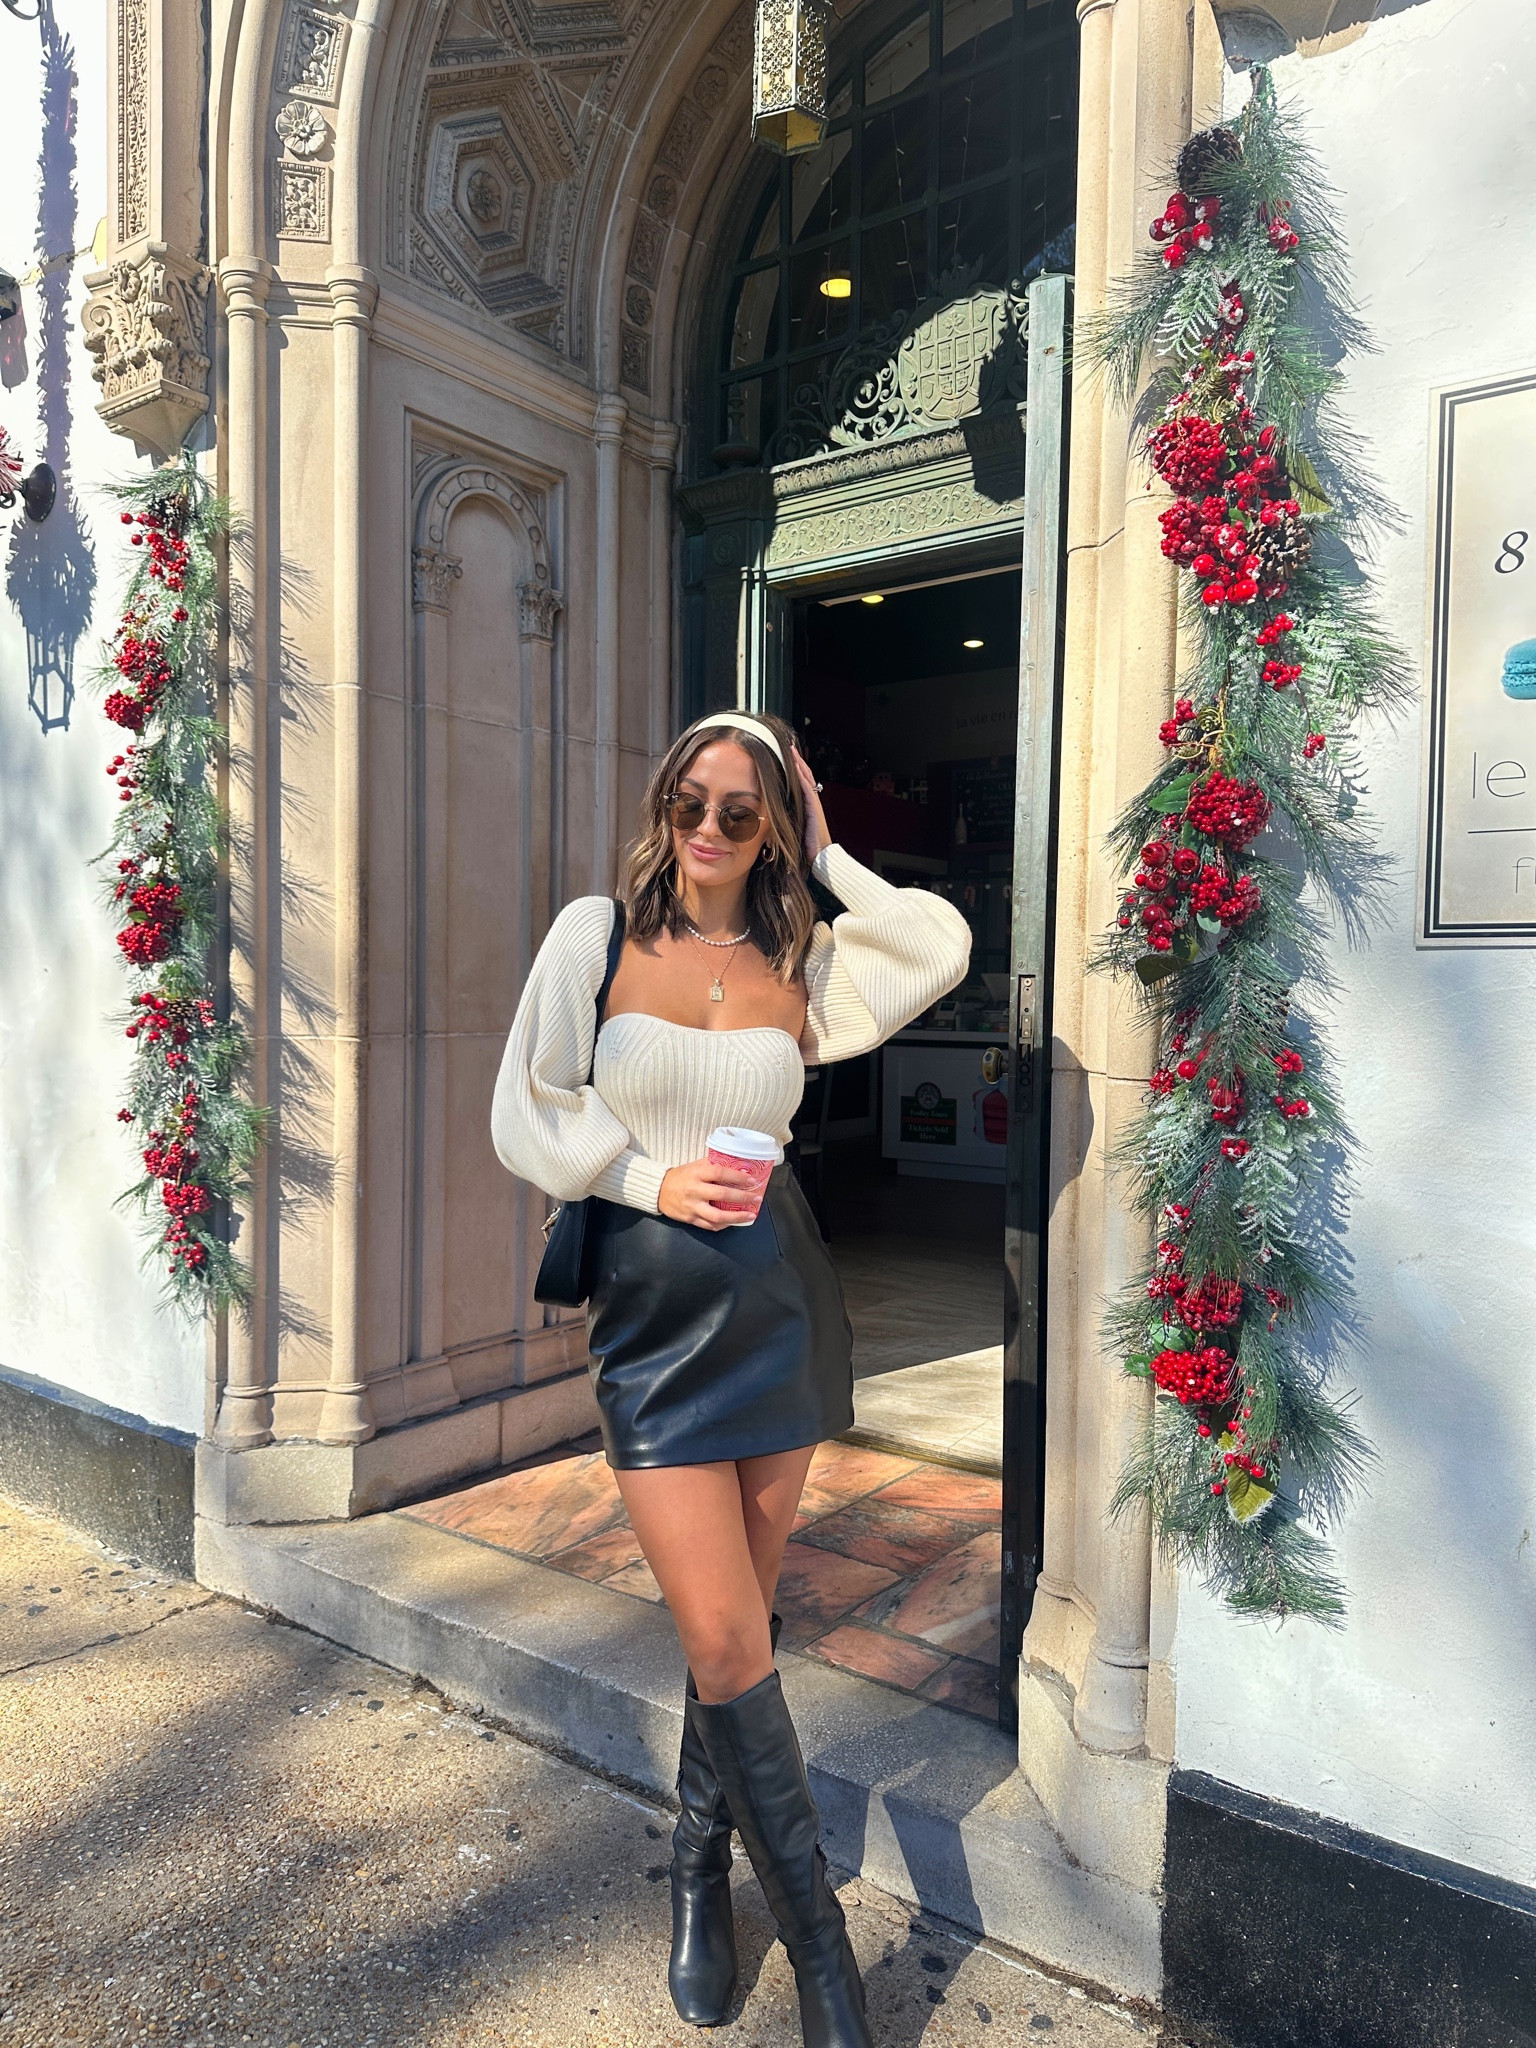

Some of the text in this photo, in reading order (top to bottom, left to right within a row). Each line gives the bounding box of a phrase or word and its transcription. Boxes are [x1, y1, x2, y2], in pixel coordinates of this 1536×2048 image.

[1494, 530, 1529, 574] 8
[1472, 751, 1527, 799] le
[1511, 856, 1536, 894] f
[909, 1124, 932, 1132] Tickets
[919, 1132, 936, 1140] Here
